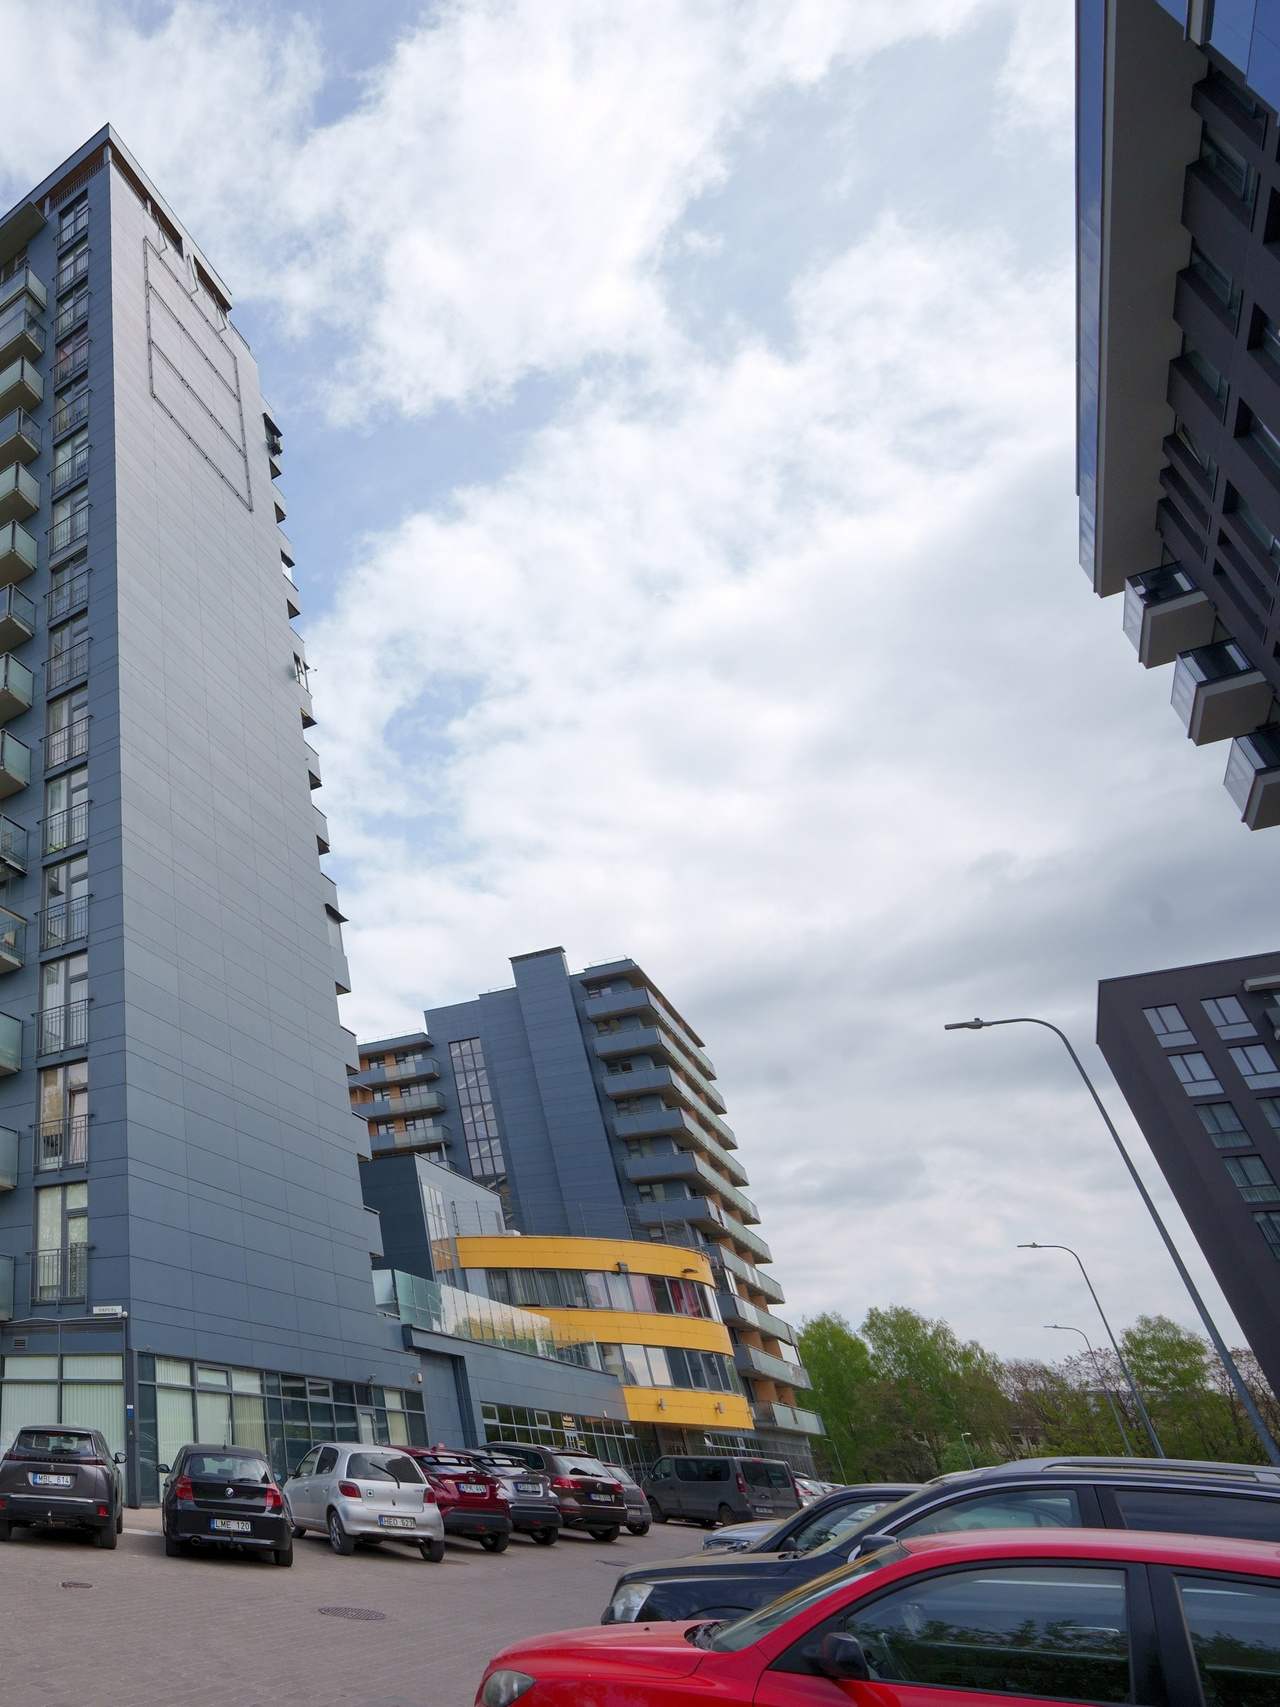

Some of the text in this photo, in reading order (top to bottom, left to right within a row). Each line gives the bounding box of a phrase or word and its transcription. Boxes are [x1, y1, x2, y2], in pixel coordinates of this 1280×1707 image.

[38, 1474, 70, 1484] MBL 614
[215, 1520, 250, 1530] LME 120
